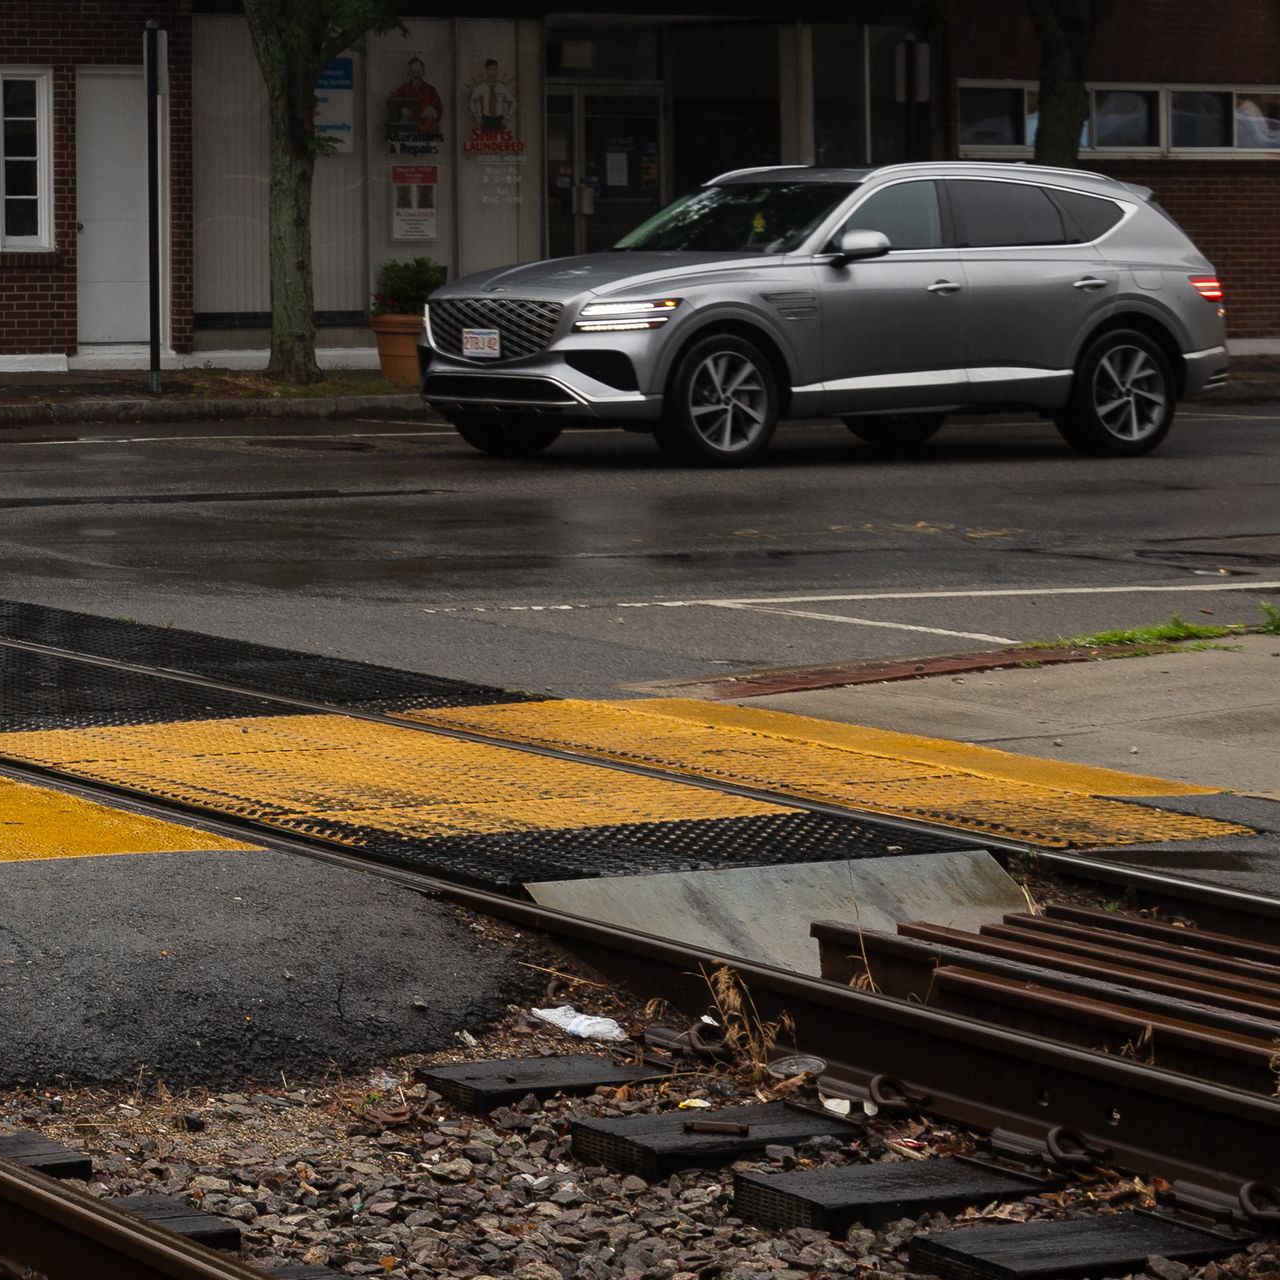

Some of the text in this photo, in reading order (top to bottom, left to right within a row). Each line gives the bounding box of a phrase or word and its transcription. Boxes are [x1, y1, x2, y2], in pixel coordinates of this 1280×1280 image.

[471, 128, 513, 141] Shirts
[400, 144, 439, 157] Repairs
[463, 142, 524, 152] LAUNDERED
